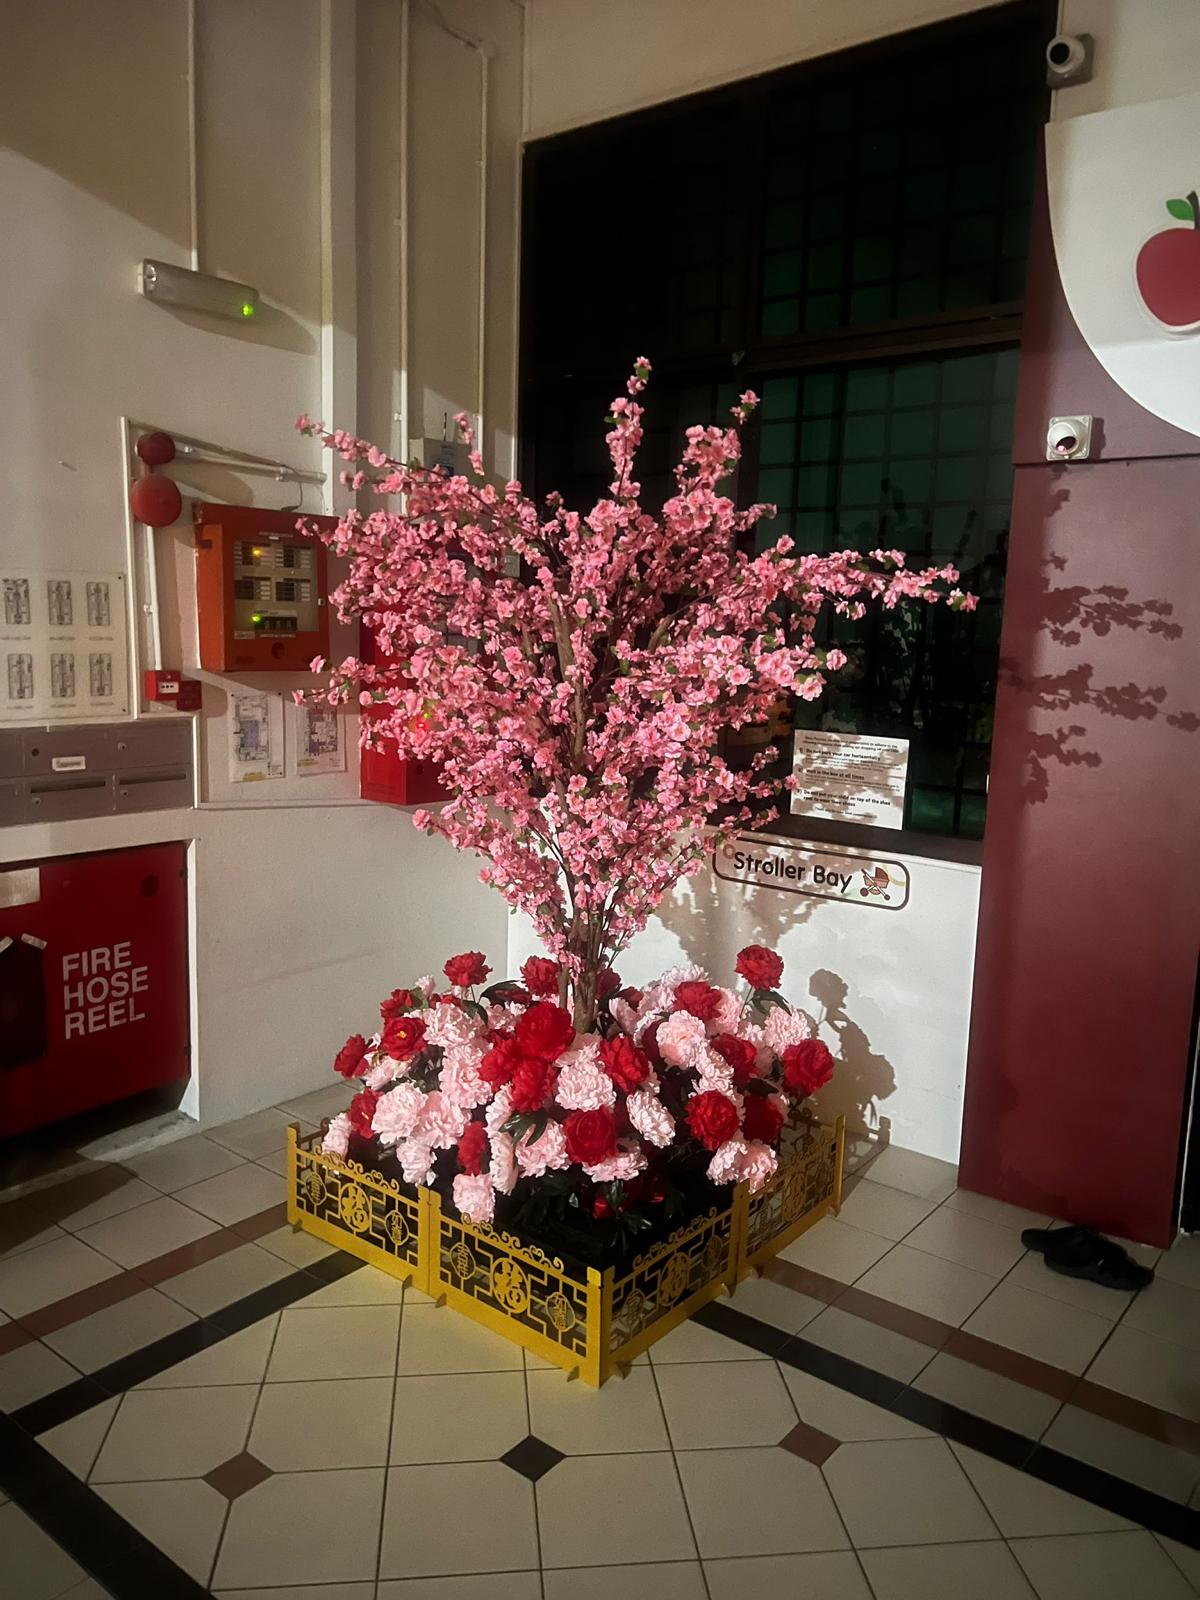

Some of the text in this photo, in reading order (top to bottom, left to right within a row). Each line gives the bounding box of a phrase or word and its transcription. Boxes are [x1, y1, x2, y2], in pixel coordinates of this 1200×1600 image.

[733, 852, 853, 893] Stroller Bay
[63, 941, 132, 981] FIRE
[64, 966, 148, 1010] HOSE
[65, 998, 145, 1039] REEL
